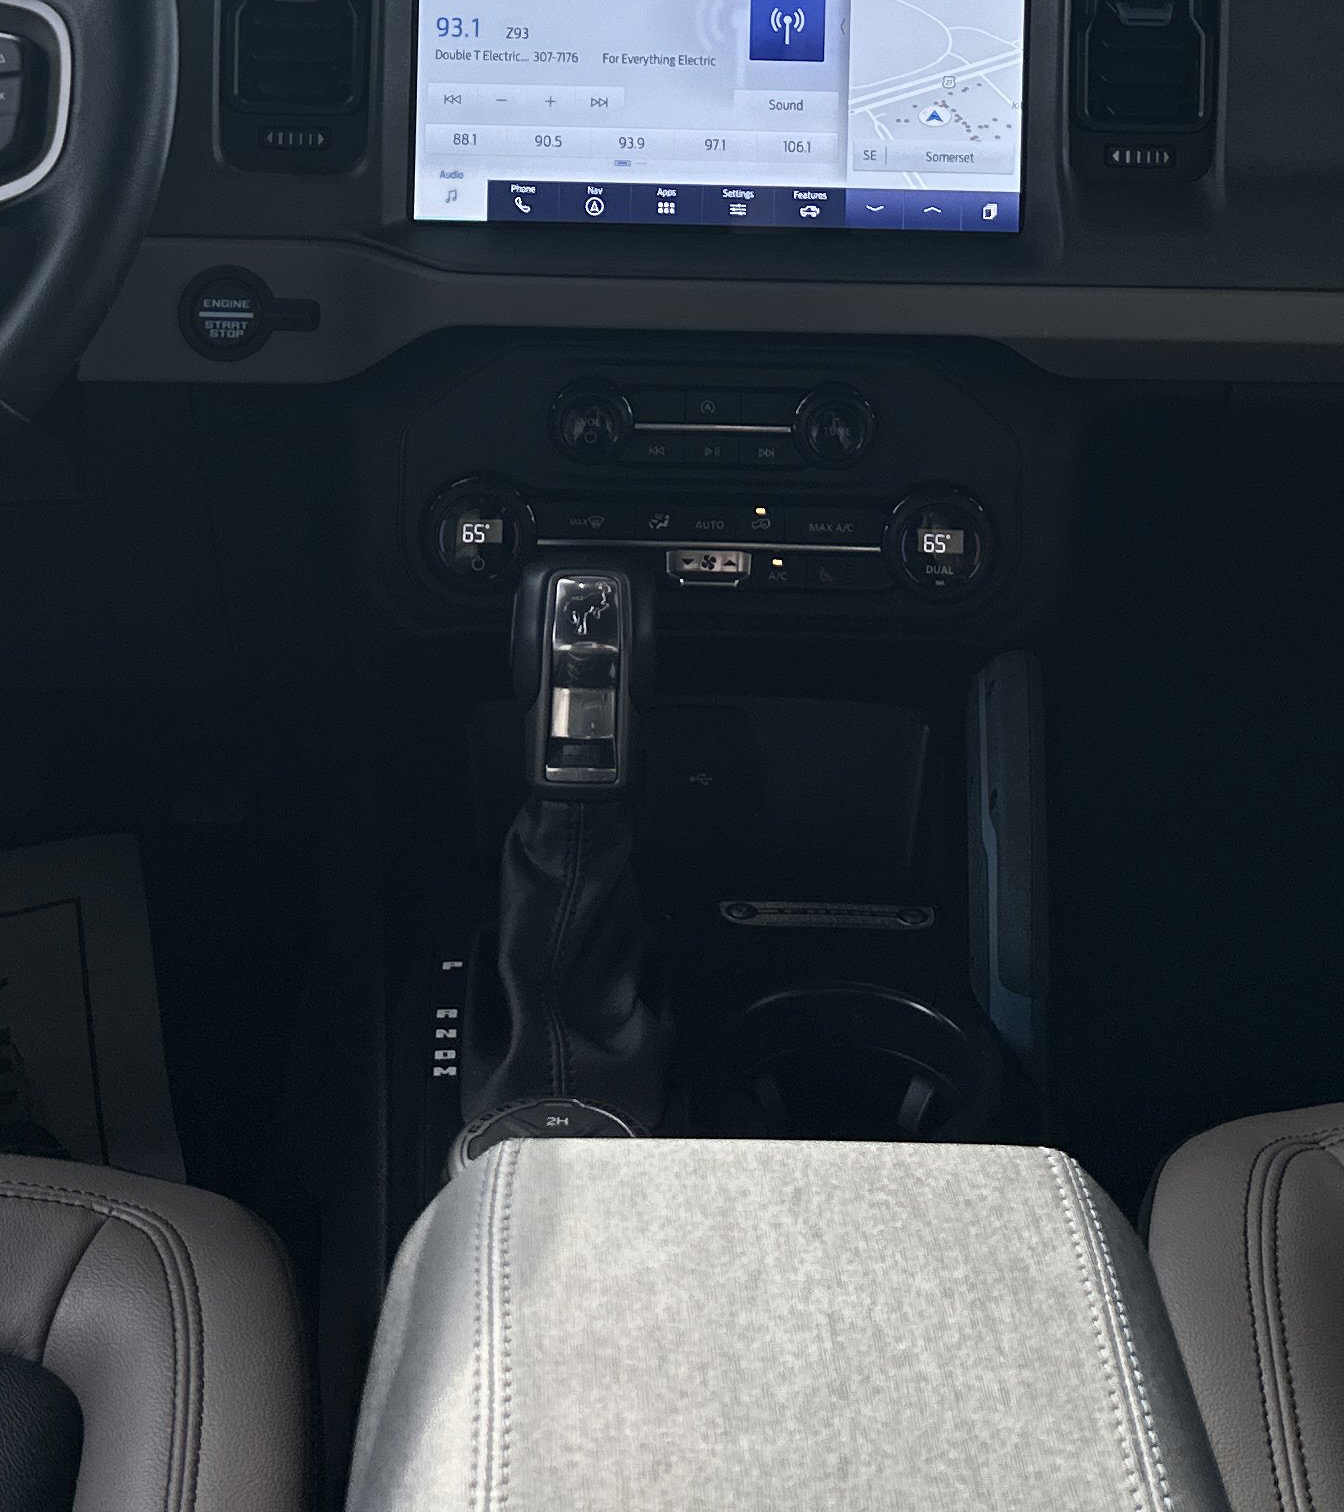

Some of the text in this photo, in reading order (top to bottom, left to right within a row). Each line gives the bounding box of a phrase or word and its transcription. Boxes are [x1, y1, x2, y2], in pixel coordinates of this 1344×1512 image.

[436, 17, 529, 39] 93.1 Z93
[435, 49, 472, 61] Double
[473, 50, 481, 61] T
[533, 51, 579, 63] 307-7176
[602, 53, 716, 68] For Everything Electric
[768, 99, 804, 111] Sound
[453, 133, 812, 154] 88.1 90.5 93.9 97.1 106.1
[863, 149, 975, 163] SE Somerset
[439, 170, 464, 179] Audio
[511, 184, 536, 194] Phone
[587, 186, 604, 195] Nav
[657, 188, 677, 198] Apps
[722, 189, 755, 200] Settings
[793, 190, 827, 200] Features
[203, 298, 250, 308] ENGINE
[204, 320, 249, 330] START
[209, 329, 244, 338] STOP
[581, 418, 601, 427] VOL
[695, 520, 725, 530] AUTO
[809, 522, 854, 534] MAX A/C
[462, 523, 490, 543] 65°
[923, 533, 951, 554] 65°
[926, 565, 954, 575] DUAL
[768, 570, 787, 581] A/C
[435, 1028, 457, 1038] N
[432, 1066, 457, 1077] M
[546, 1116, 569, 1126] 2H
